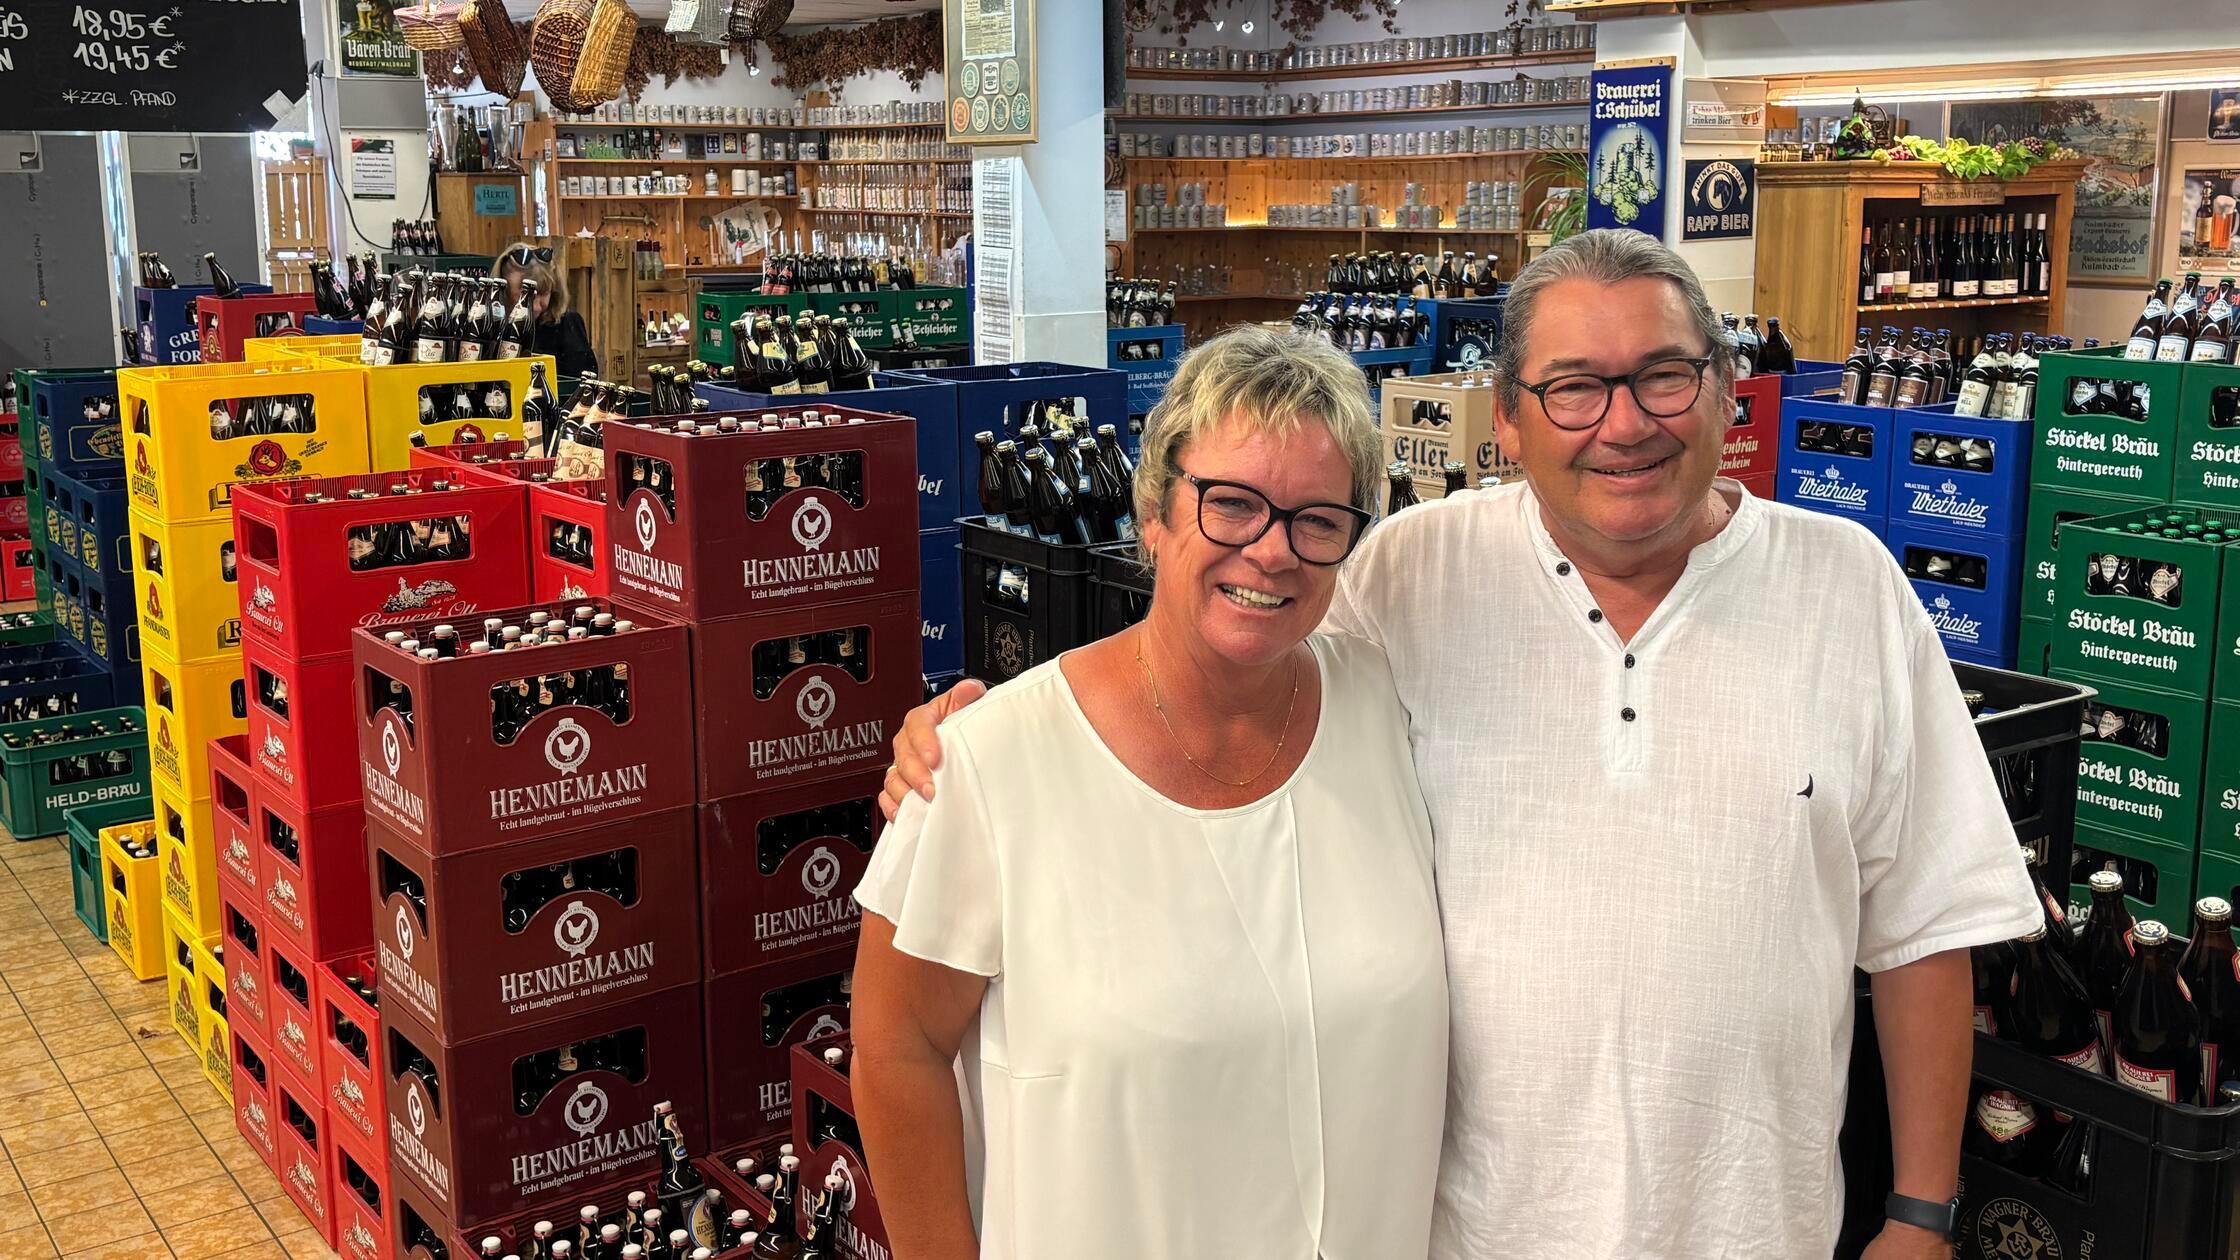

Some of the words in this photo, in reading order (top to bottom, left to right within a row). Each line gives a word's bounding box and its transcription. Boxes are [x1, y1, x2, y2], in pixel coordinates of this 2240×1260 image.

[346, 39, 411, 58] Bären-Bräu
[130, 90, 176, 106] PFAND
[1596, 78, 1661, 100] Brauerei
[1694, 165, 1716, 190] TRINKT
[1716, 162, 1731, 171] DAS
[1731, 167, 1745, 188] GUTE
[1687, 215, 1719, 233] RAPP
[1720, 213, 1750, 231] BIER
[2081, 263, 2120, 271] Kulmbach
[912, 323, 958, 337] Schleicher
[1394, 436, 1448, 469] Eller
[2045, 427, 2107, 451] Stöckel
[2112, 434, 2160, 457] Bräu
[2057, 456, 2143, 480] Hintergereuth
[1798, 476, 1869, 502] Wiethaler
[1912, 491, 1989, 518] Wiethaler
[614, 543, 684, 590] HENNEMANN
[743, 547, 880, 588] HENNEMANN
[751, 588, 767, 600] Echt
[768, 584, 808, 599] landgebraut
[814, 581, 823, 590] im
[824, 575, 874, 591] Bügelverschluss
[358, 607, 442, 627] Brauerei
[448, 601, 477, 618] Ott
[2068, 608, 2137, 638] Stöckel
[2142, 620, 2197, 649] Bräu
[2080, 640, 2178, 672] Hintergereuth
[748, 720, 884, 769] HENNEMANN
[756, 767, 772, 780] Echt
[773, 761, 813, 776] landgebraut
[818, 758, 827, 767] im
[828, 749, 878, 766] Bügelverschluss
[45, 783, 141, 809] HELD-BRÄU
[365, 761, 424, 826] HENNEMANN
[490, 763, 648, 819] HENNEMANN
[2128, 768, 2182, 799] Bräu
[500, 818, 518, 831] Echt
[519, 810, 566, 828] landgebraut
[571, 807, 582, 816] im
[583, 795, 641, 814] Bügelverschluss
[2077, 786, 2163, 822] intergereuth
[754, 894, 861, 941] HENNEMA
[762, 940, 778, 951] Echt
[778, 933, 817, 948] landgebraut
[823, 927, 832, 936] im
[833, 921, 861, 934] Bügelver
[379, 940, 437, 1012] HENNEMANN
[500, 941, 655, 1003] HENNEMANN
[510, 1002, 528, 1015] Echt
[529, 992, 575, 1010] landgebraut
[580, 987, 591, 997] im
[592, 973, 648, 994] Bügelverschluss
[2121, 1061, 2154, 1078] BRAUEREI
[2124, 1067, 2152, 1082] WAGNER
[332, 1084, 361, 1119] Brauerei
[766, 1110, 783, 1122] Echt
[1990, 1100, 2016, 1112] WAGNER
[390, 1112, 449, 1193] HENNEMANN
[521, 1183, 539, 1196] Echt
[540, 1171, 585, 1190] landgebraut
[589, 1166, 600, 1175] im
[601, 1149, 657, 1173] Bügelverschluss
[1981, 1201, 2029, 1229] WAGNER
[2031, 1216, 2060, 1257] BRÄU
